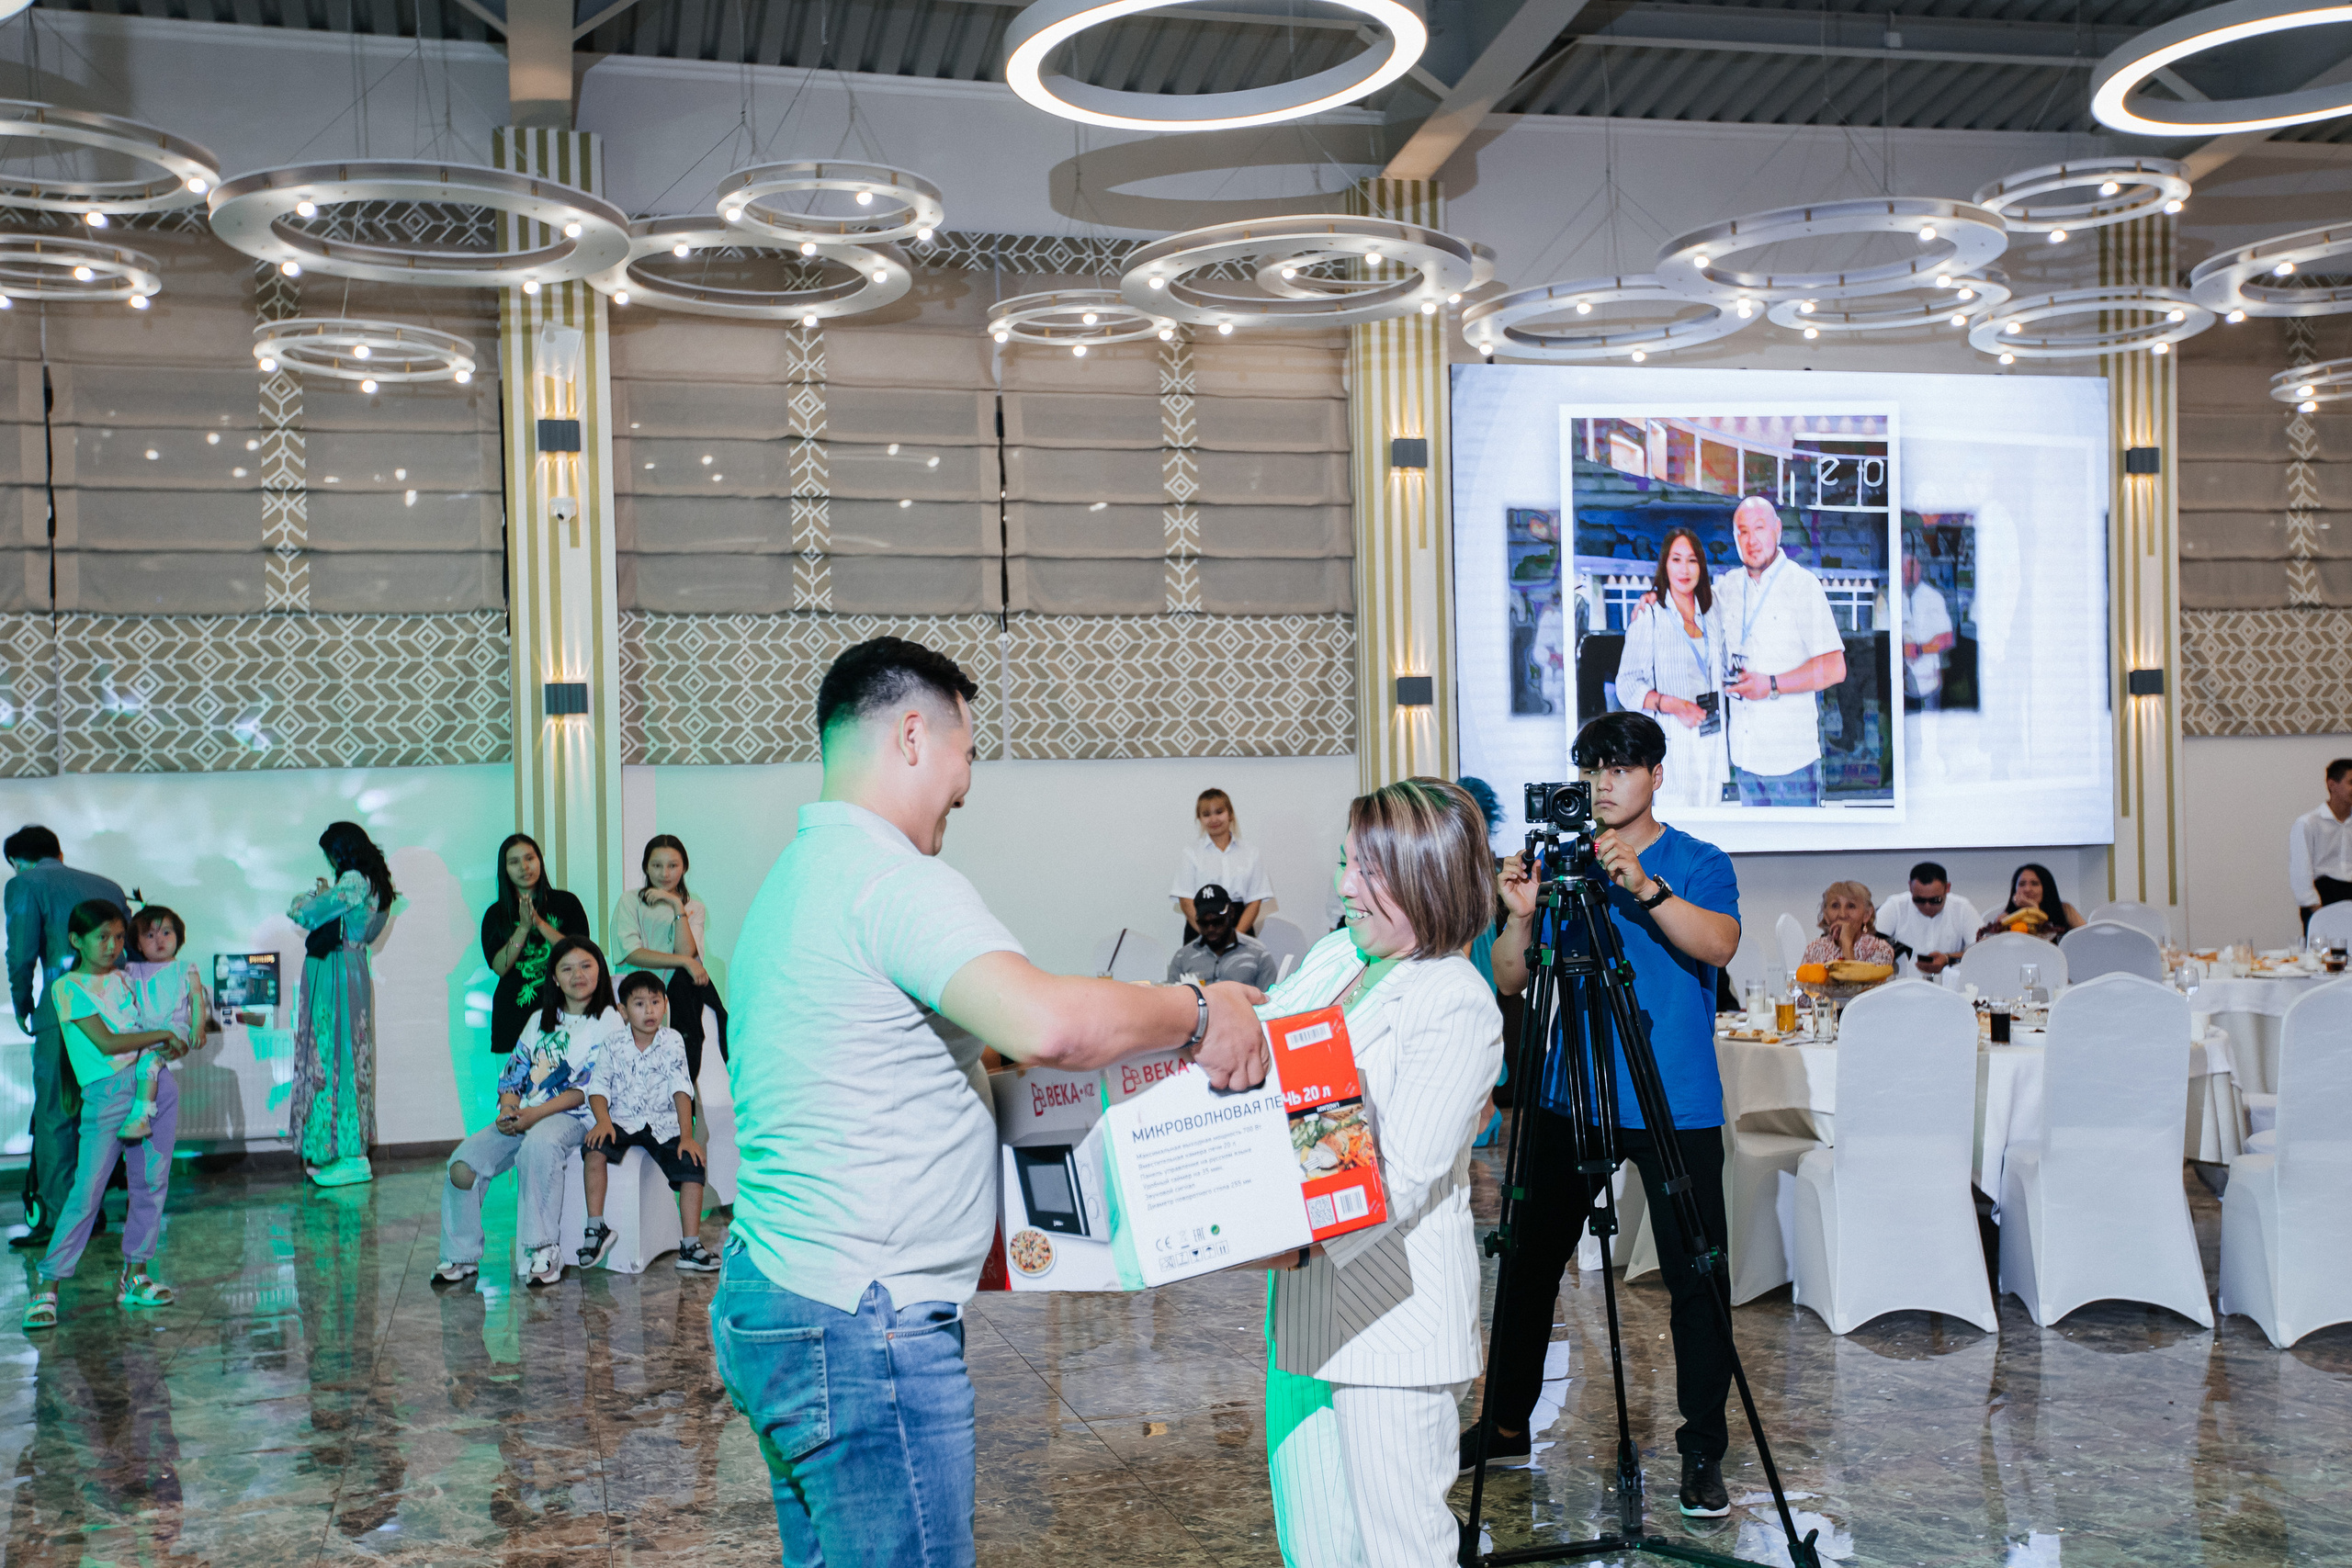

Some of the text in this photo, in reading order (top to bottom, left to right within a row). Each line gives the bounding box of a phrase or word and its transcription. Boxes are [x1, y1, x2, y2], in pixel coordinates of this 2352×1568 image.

[249, 954, 275, 964] PHILIPS
[1132, 1100, 1261, 1143] МИКРОВОЛНОВАЯ
[1303, 1085, 1320, 1102] 20
[1322, 1085, 1331, 1099] л
[1147, 1199, 1174, 1211] Диаметр
